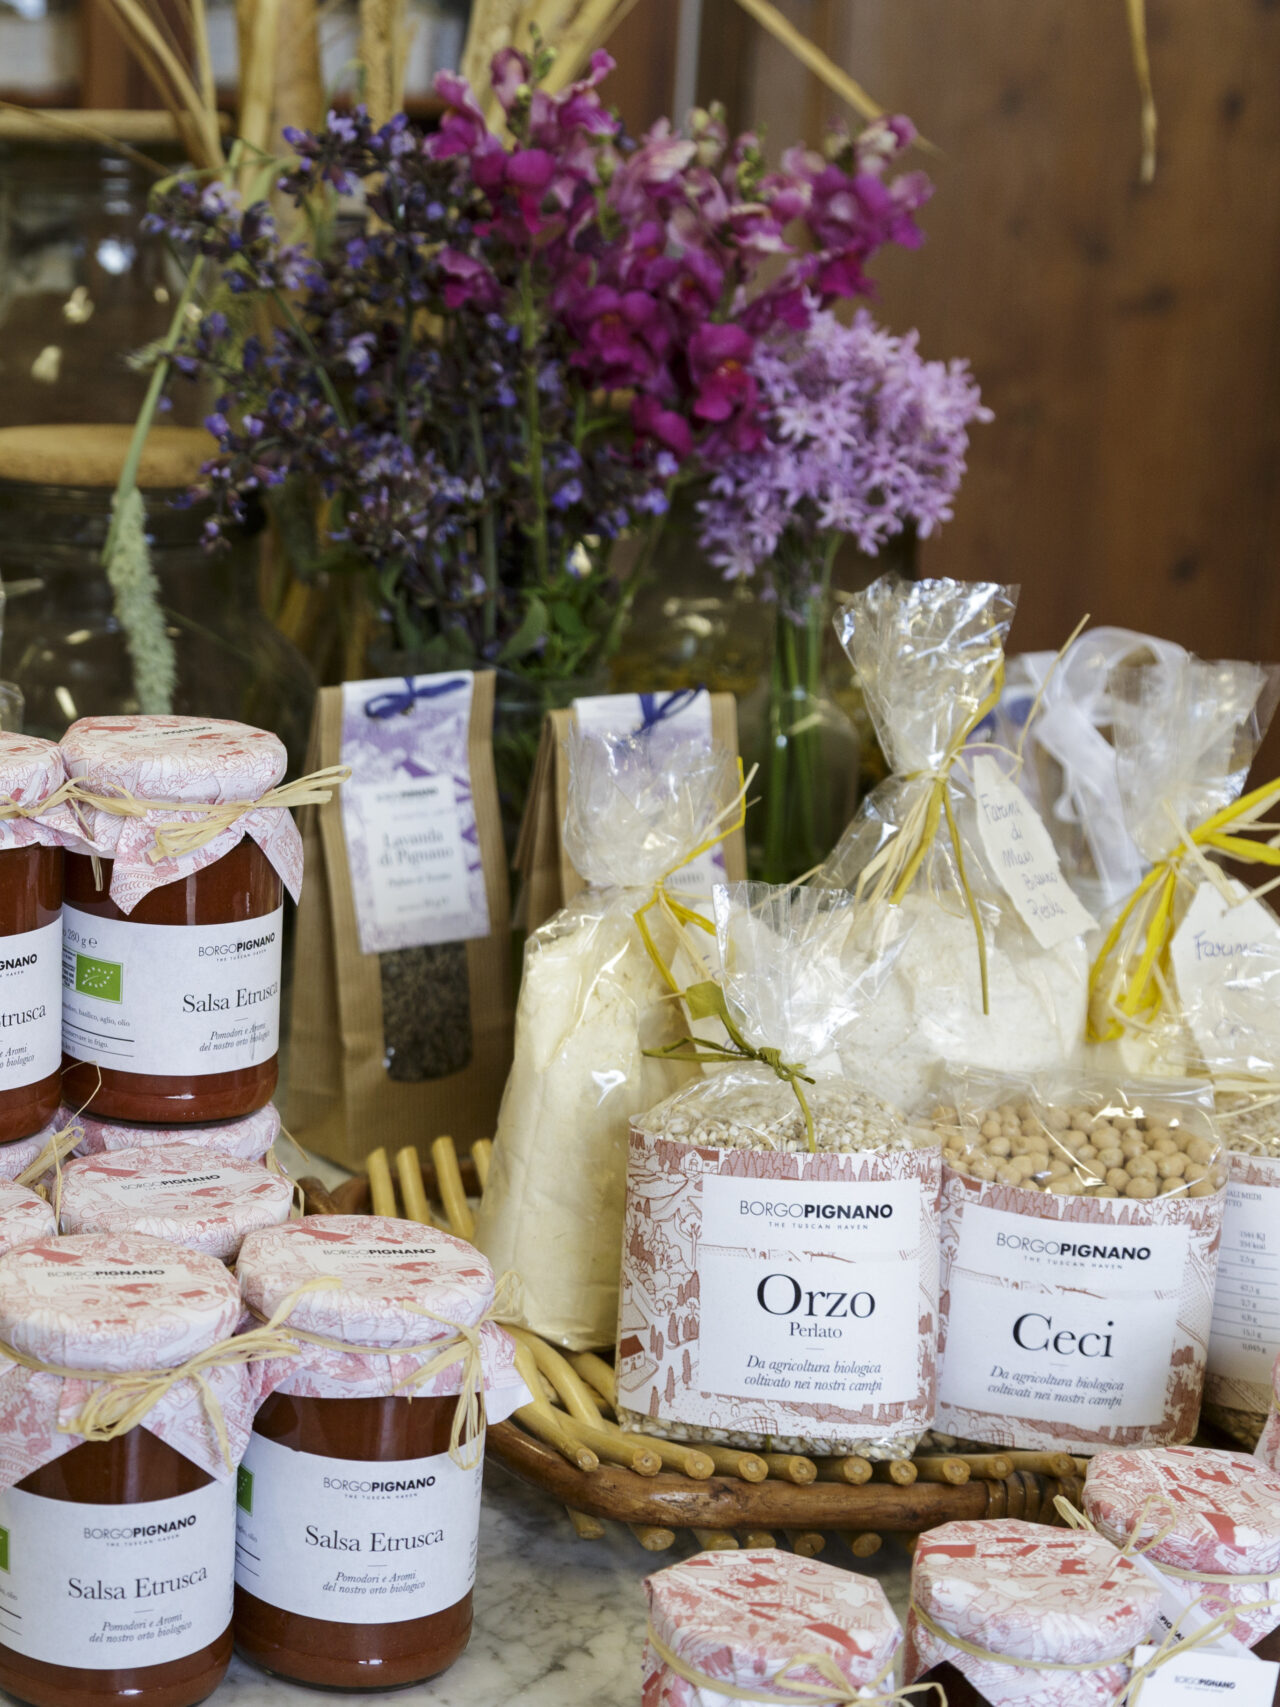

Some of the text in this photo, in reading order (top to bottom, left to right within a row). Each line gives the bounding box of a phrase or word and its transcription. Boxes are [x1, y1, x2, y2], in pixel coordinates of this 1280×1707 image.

[199, 933, 275, 956] BORGOPIGNANO
[183, 982, 278, 1013] Salsa Etrusca
[200, 1041, 211, 1052] del
[214, 1040, 234, 1049] nostro
[236, 1038, 248, 1046] orto
[211, 1028, 243, 1040] Pomodori
[5, 1043, 27, 1057] Aromi
[6, 1054, 34, 1068] biologico
[740, 1200, 893, 1219] BORGOPIGNANO
[997, 1232, 1151, 1260] BORGOPIGNANO
[757, 1273, 875, 1318] Orzo
[790, 1322, 842, 1338] Perlato
[1012, 1313, 1114, 1358] Ceci
[747, 1355, 881, 1377] Da agricoltura biologica
[745, 1373, 883, 1395] coltivato nei nostri campi
[990, 1365, 1124, 1392] Da agricoltura biologica
[988, 1382, 1122, 1410] coltivati nei nostri campi
[323, 1476, 436, 1492] BORGOPIGNANO
[84, 1515, 196, 1539] BORGOPIGNANO
[305, 1525, 444, 1552] Salsa Etrusca
[68, 1567, 208, 1600] Salsa Etrusca
[323, 1580, 425, 1594] del nostro orto biologico
[336, 1572, 379, 1583] Pomodori
[389, 1570, 416, 1583] Aromi
[89, 1619, 192, 1643] del nostro orto biologico
[102, 1620, 146, 1632] Pomodori
[155, 1612, 182, 1627] Aromi
